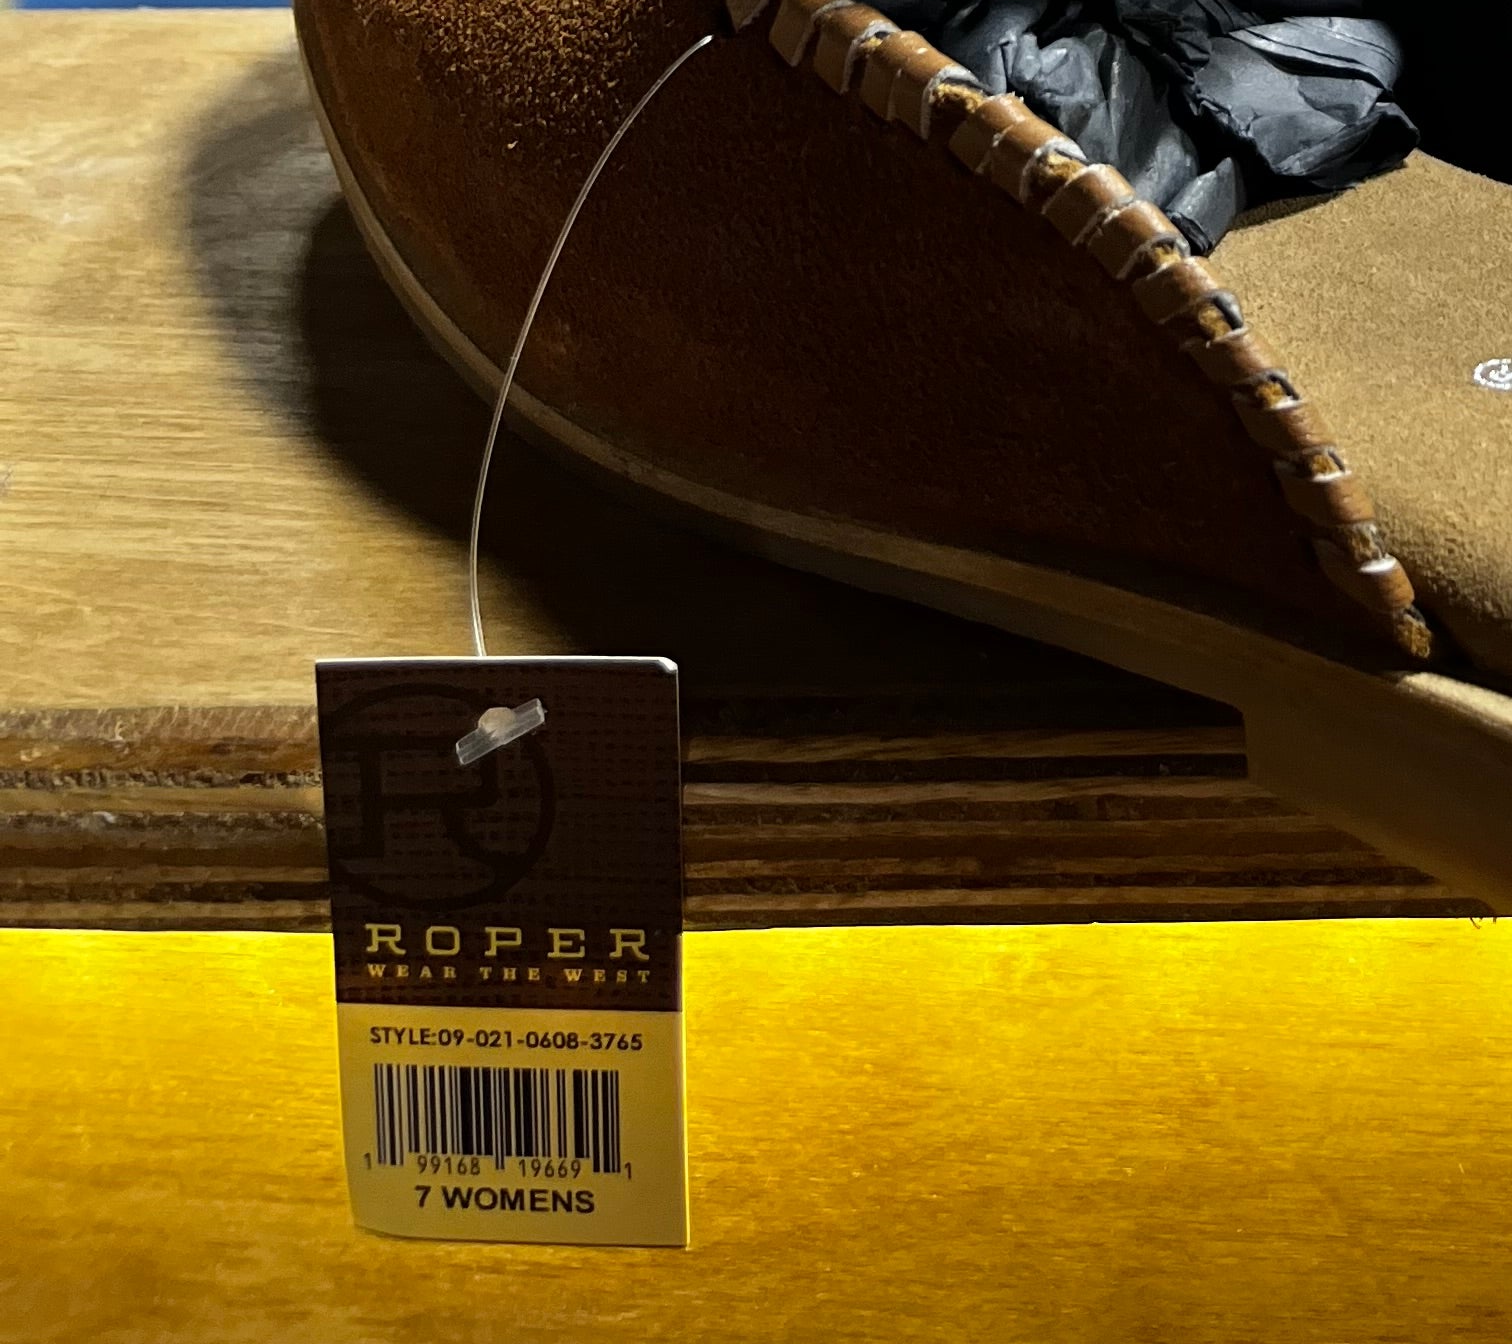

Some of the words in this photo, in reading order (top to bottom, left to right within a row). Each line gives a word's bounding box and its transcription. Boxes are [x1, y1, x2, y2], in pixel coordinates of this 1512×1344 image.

[365, 923, 650, 960] ROPER
[367, 963, 456, 979] WEAR
[479, 966, 540, 981] THE
[563, 968, 650, 983] WEST
[370, 1026, 643, 1051] STYLE:09-021-0608-3765
[364, 1152, 372, 1171] 1
[417, 1154, 481, 1176] 99168
[518, 1159, 581, 1179] 19669
[624, 1162, 632, 1180] 1
[414, 1184, 432, 1208] 7
[442, 1186, 595, 1213] WOMENS
